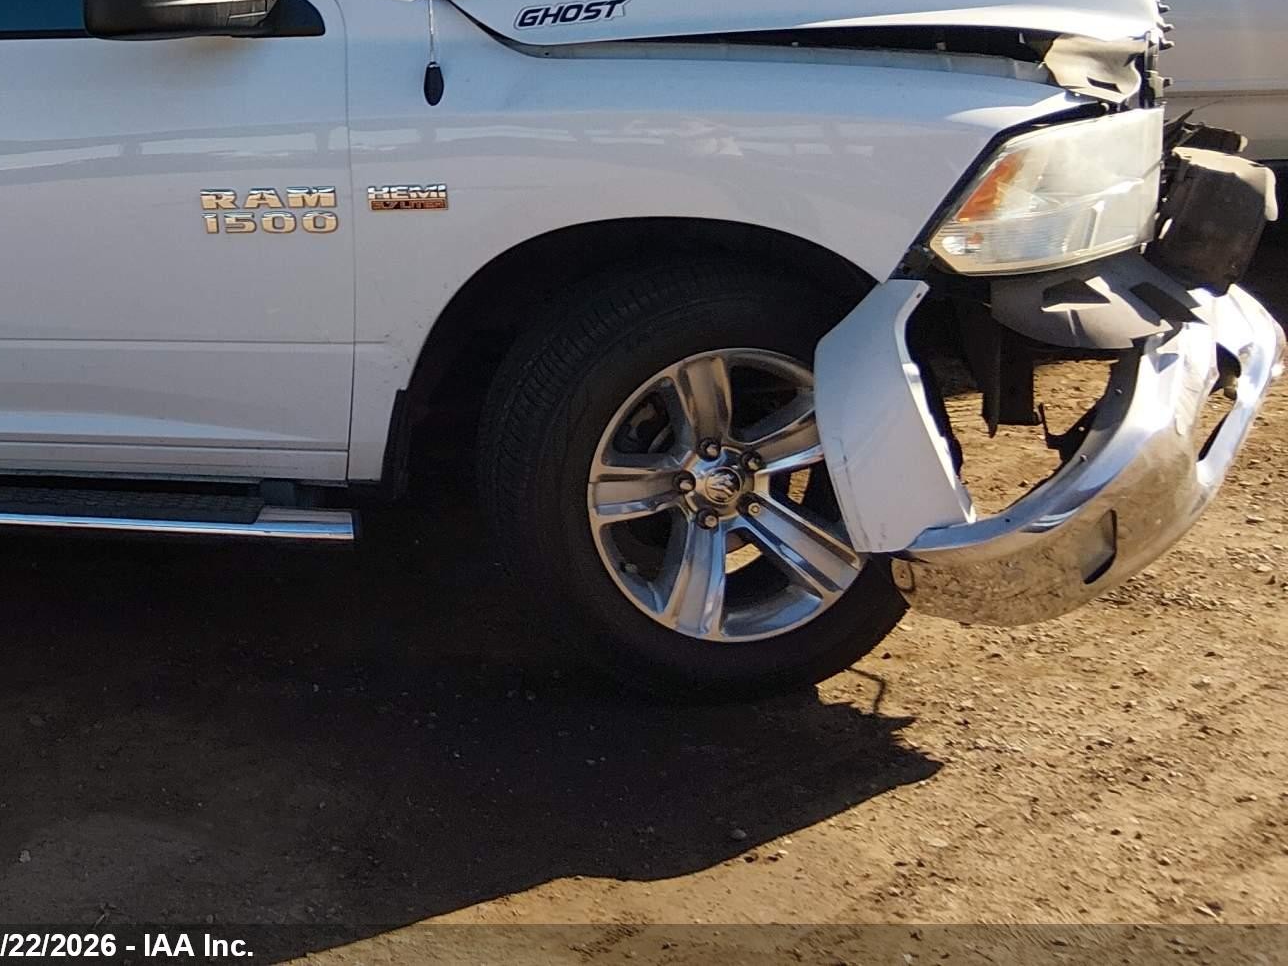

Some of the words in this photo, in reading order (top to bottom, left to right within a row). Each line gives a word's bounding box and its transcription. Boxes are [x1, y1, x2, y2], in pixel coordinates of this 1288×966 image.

[199, 185, 338, 211] RAM
[367, 183, 448, 199] HEMI
[201, 210, 340, 235] 1500
